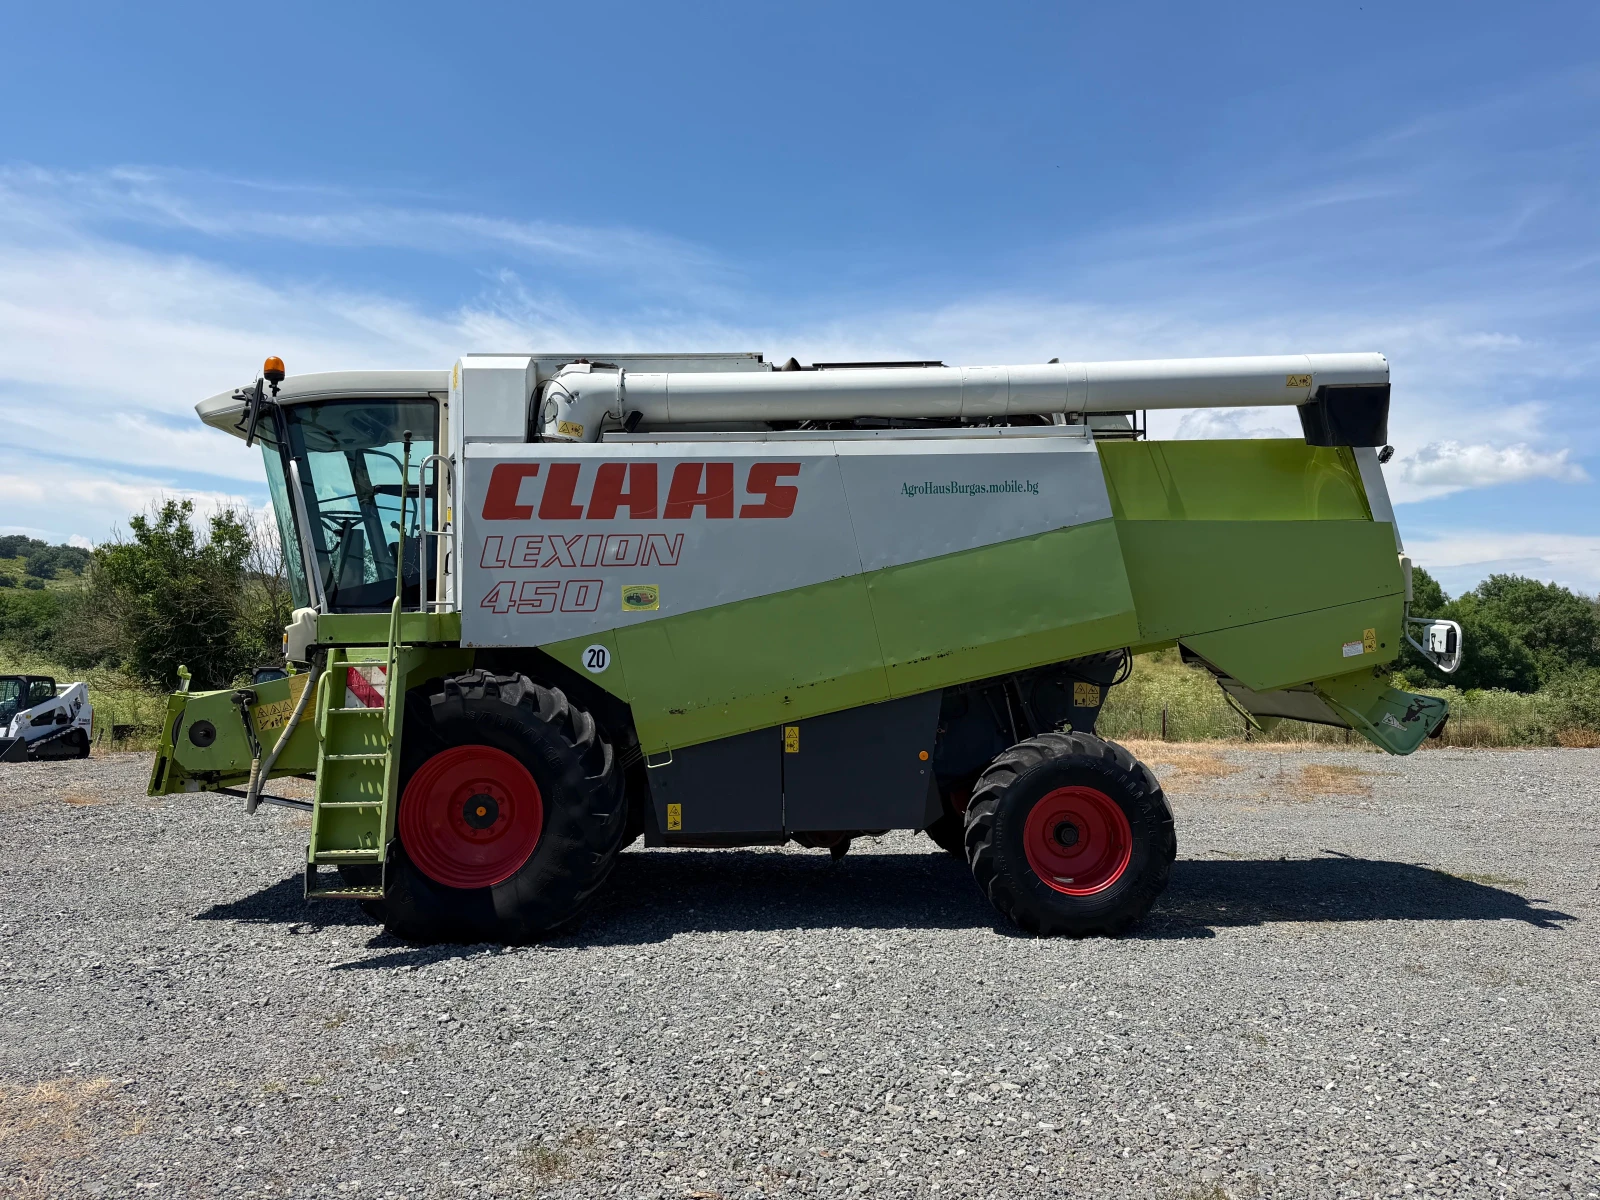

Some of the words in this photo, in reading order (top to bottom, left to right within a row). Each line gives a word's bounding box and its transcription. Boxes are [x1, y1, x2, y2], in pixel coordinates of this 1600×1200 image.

[481, 462, 802, 521] CLAAS
[900, 479, 1039, 498] AgroHausBurgas.mobile.bg
[479, 533, 684, 569] LEXION
[479, 579, 604, 614] 450
[586, 649, 606, 669] 20
